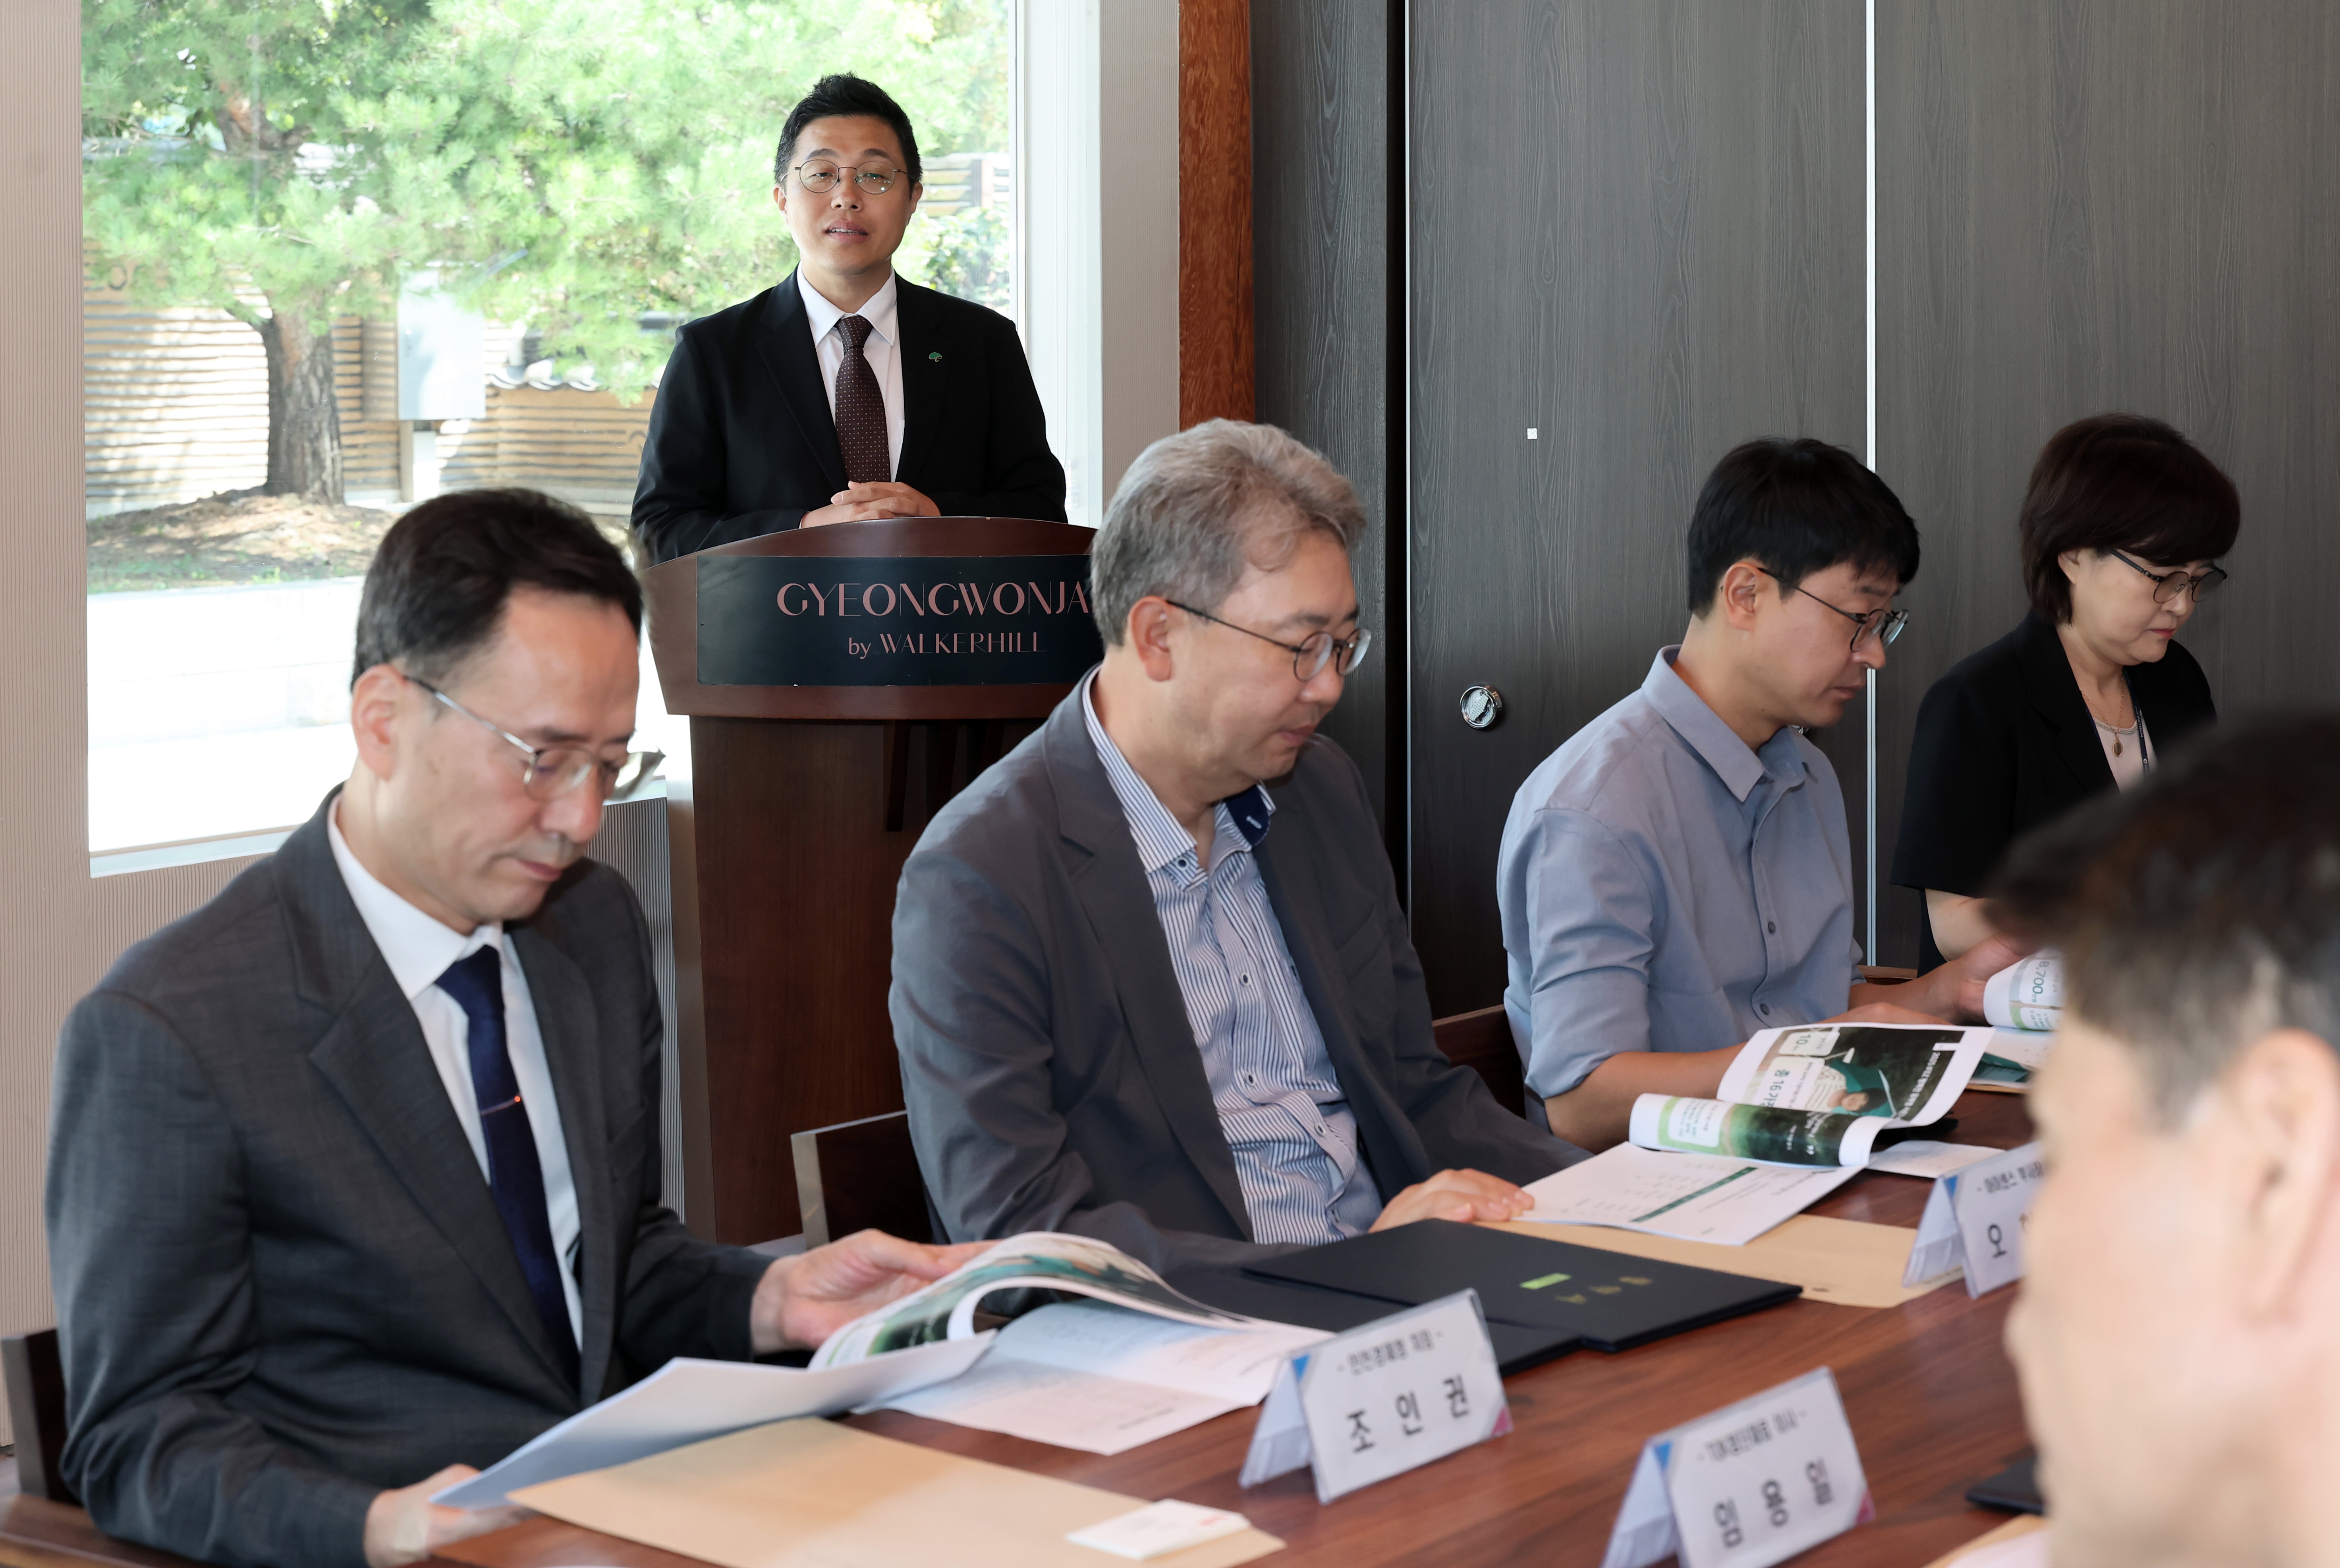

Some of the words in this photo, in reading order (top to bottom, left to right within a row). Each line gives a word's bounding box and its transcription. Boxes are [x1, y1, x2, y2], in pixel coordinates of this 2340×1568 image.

[776, 581, 1095, 616] GYEONGWONJA
[848, 637, 871, 660] by
[879, 632, 1046, 655] WALKERHILL
